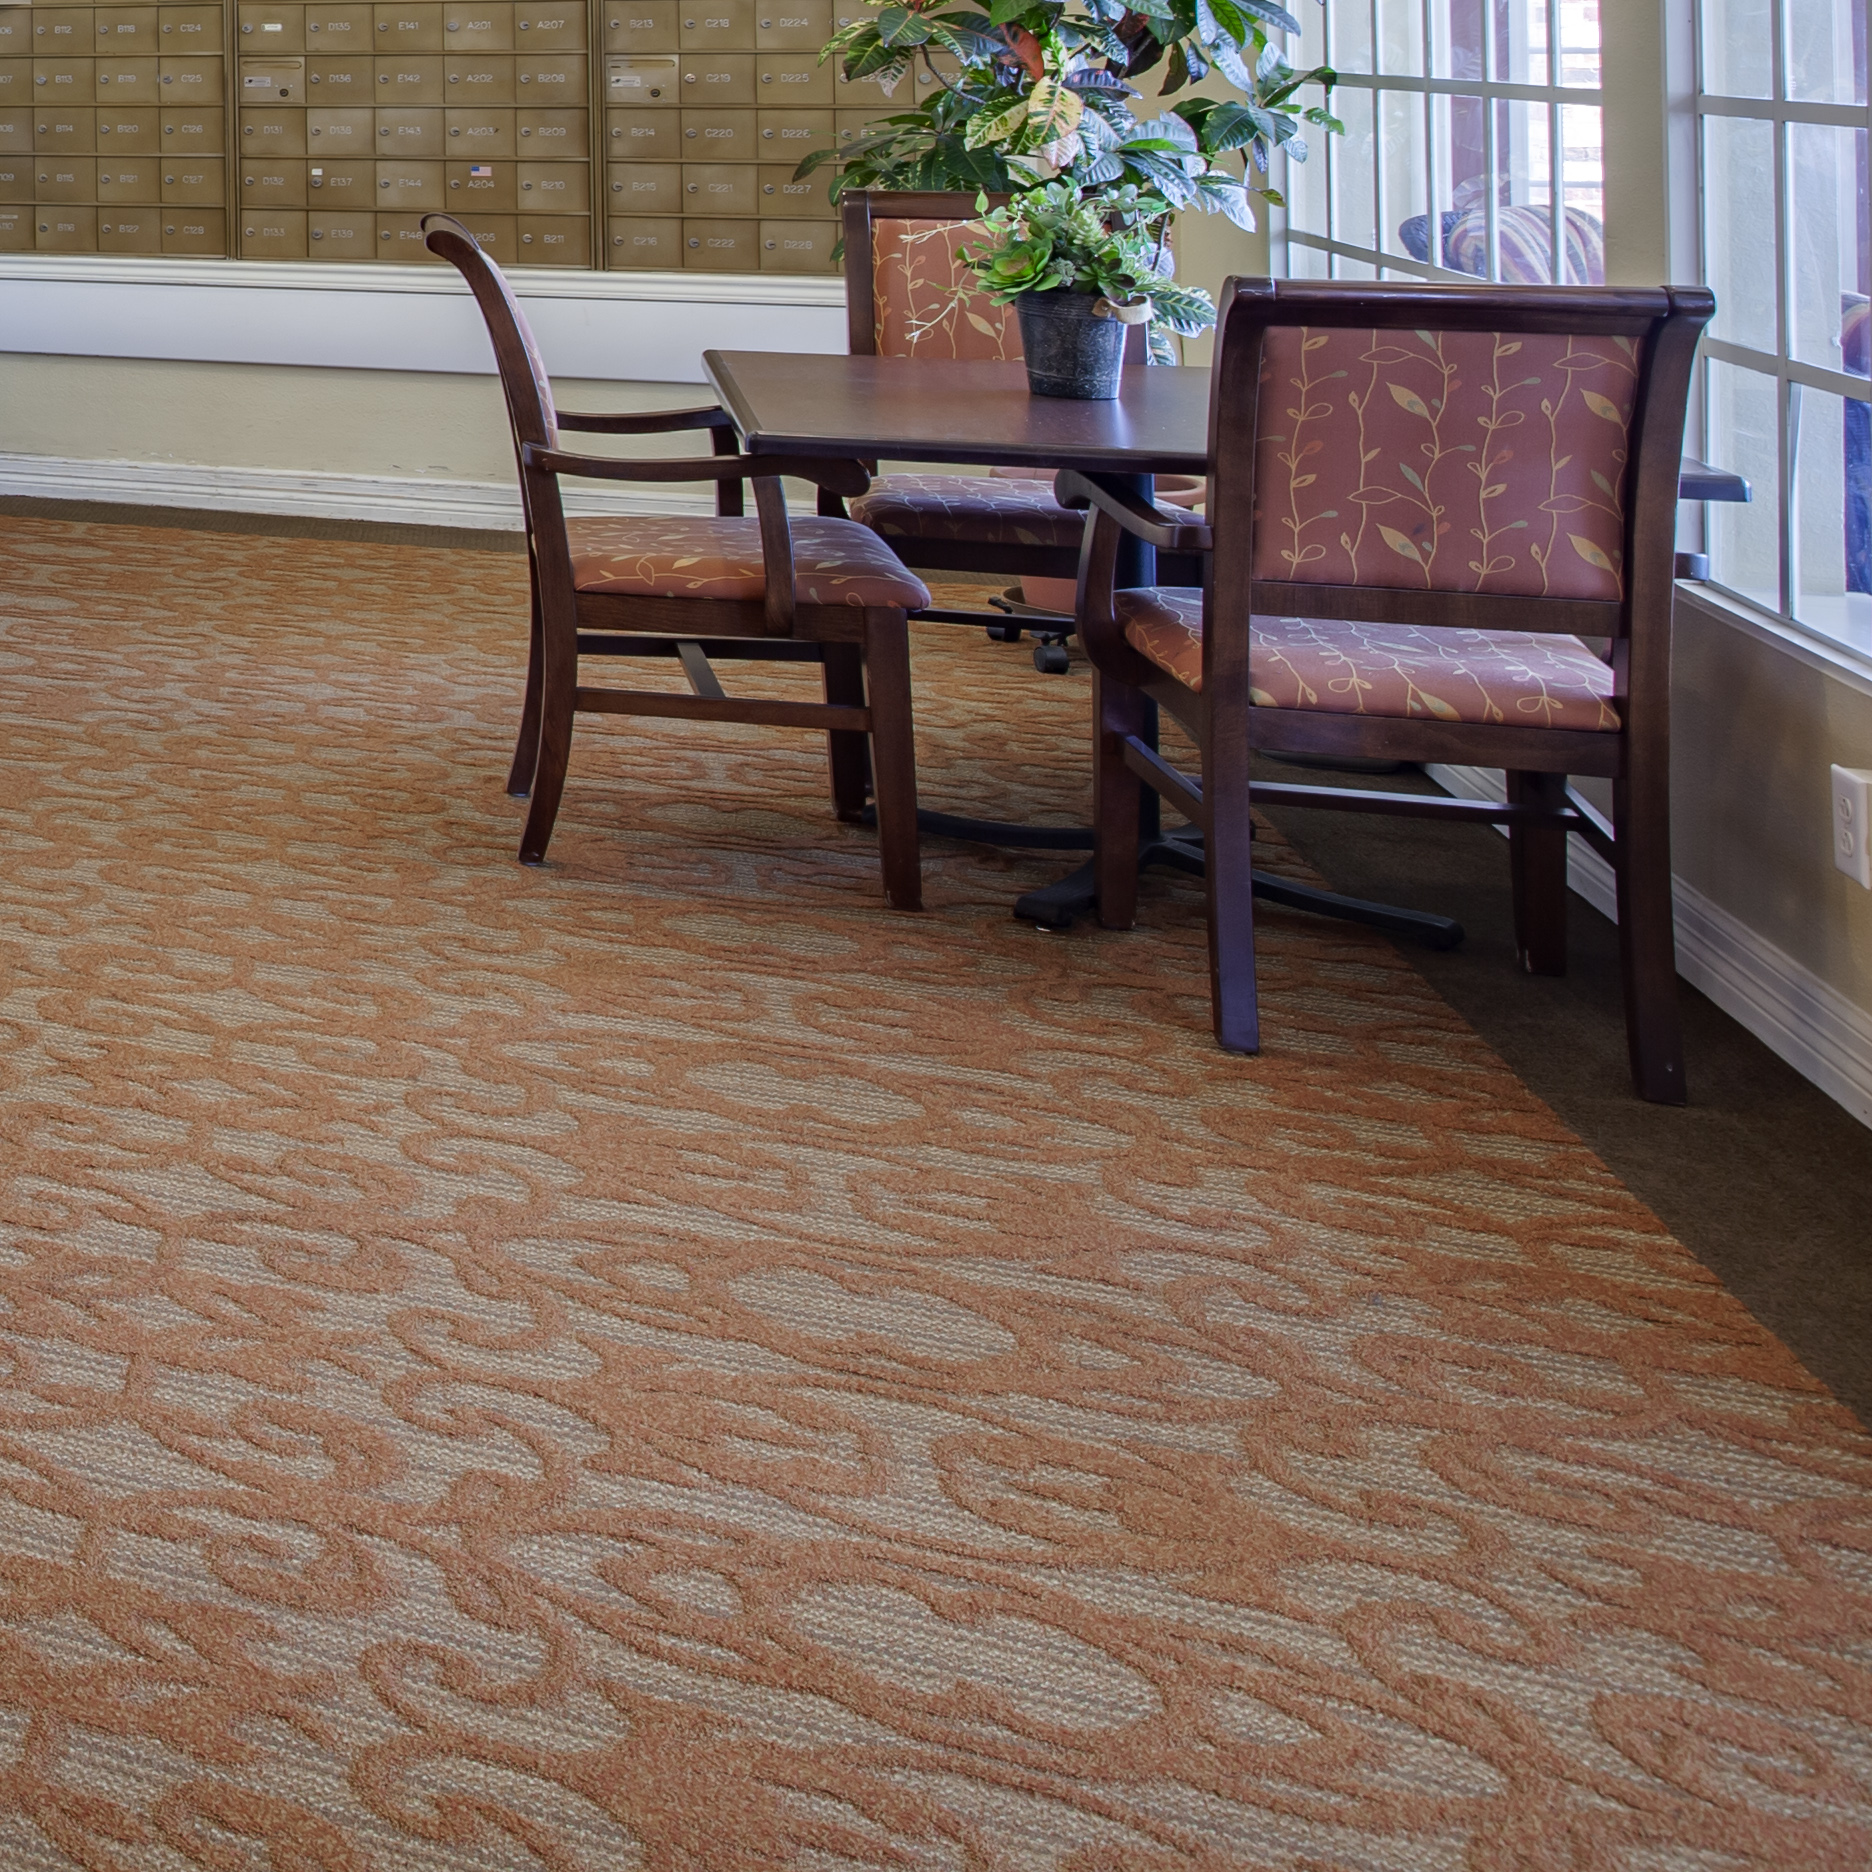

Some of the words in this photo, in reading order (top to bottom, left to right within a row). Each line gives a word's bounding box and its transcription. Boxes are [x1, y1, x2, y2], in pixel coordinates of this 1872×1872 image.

[327, 22, 351, 31] D135
[398, 21, 420, 30] E141
[466, 21, 492, 30] A201
[536, 20, 565, 29] A207
[629, 19, 654, 28] B213
[779, 17, 809, 27] D224
[54, 25, 73, 34] B112
[179, 24, 202, 32] C124
[180, 74, 203, 83] C125
[328, 74, 352, 83] D136
[397, 73, 421, 83] E142
[465, 73, 494, 83] A202
[705, 73, 732, 83] C219
[780, 73, 810, 83] D225
[55, 124, 74, 133] B114
[117, 124, 139, 133] B120
[397, 126, 422, 135] E143
[466, 127, 495, 136] A203
[538, 127, 567, 137] B209
[630, 127, 656, 137] B214
[704, 129, 734, 138] C220
[56, 173, 75, 183] B115
[119, 174, 139, 183] B121
[182, 175, 204, 184] C127
[262, 176, 285, 186] D132
[330, 177, 353, 187] E137
[398, 178, 423, 188] E144
[467, 180, 496, 189] A204
[540, 181, 566, 190] B210
[631, 182, 657, 192] B215
[708, 184, 734, 193] C221
[782, 184, 812, 194] D227
[118, 224, 140, 234] B122
[330, 229, 354, 239] E139
[543, 234, 565, 244] B211
[707, 238, 736, 248] C222
